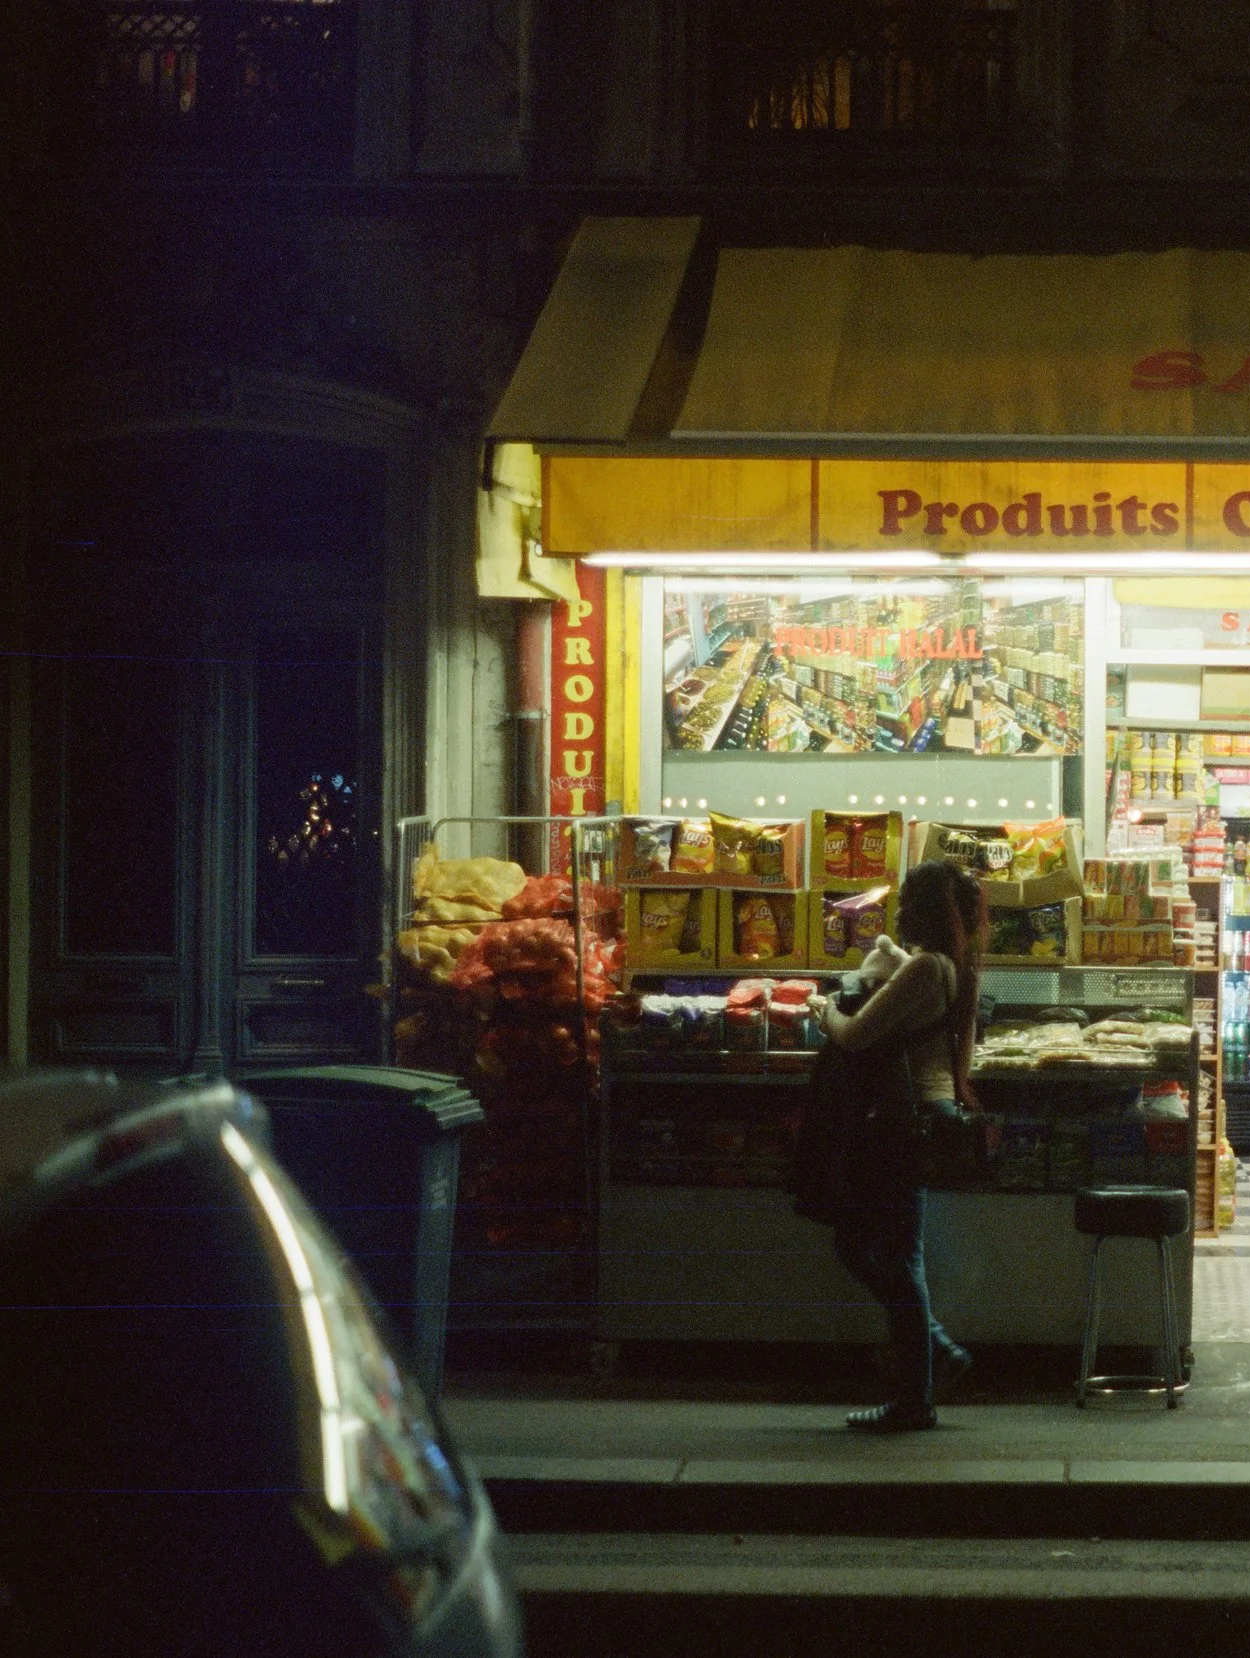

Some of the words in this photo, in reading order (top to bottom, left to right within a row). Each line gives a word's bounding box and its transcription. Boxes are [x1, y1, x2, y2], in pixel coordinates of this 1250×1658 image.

[876, 488, 1180, 537] Produits
[772, 626, 893, 659] PRODUIT
[898, 627, 984, 660] HALAL
[563, 598, 596, 876] PRODUI
